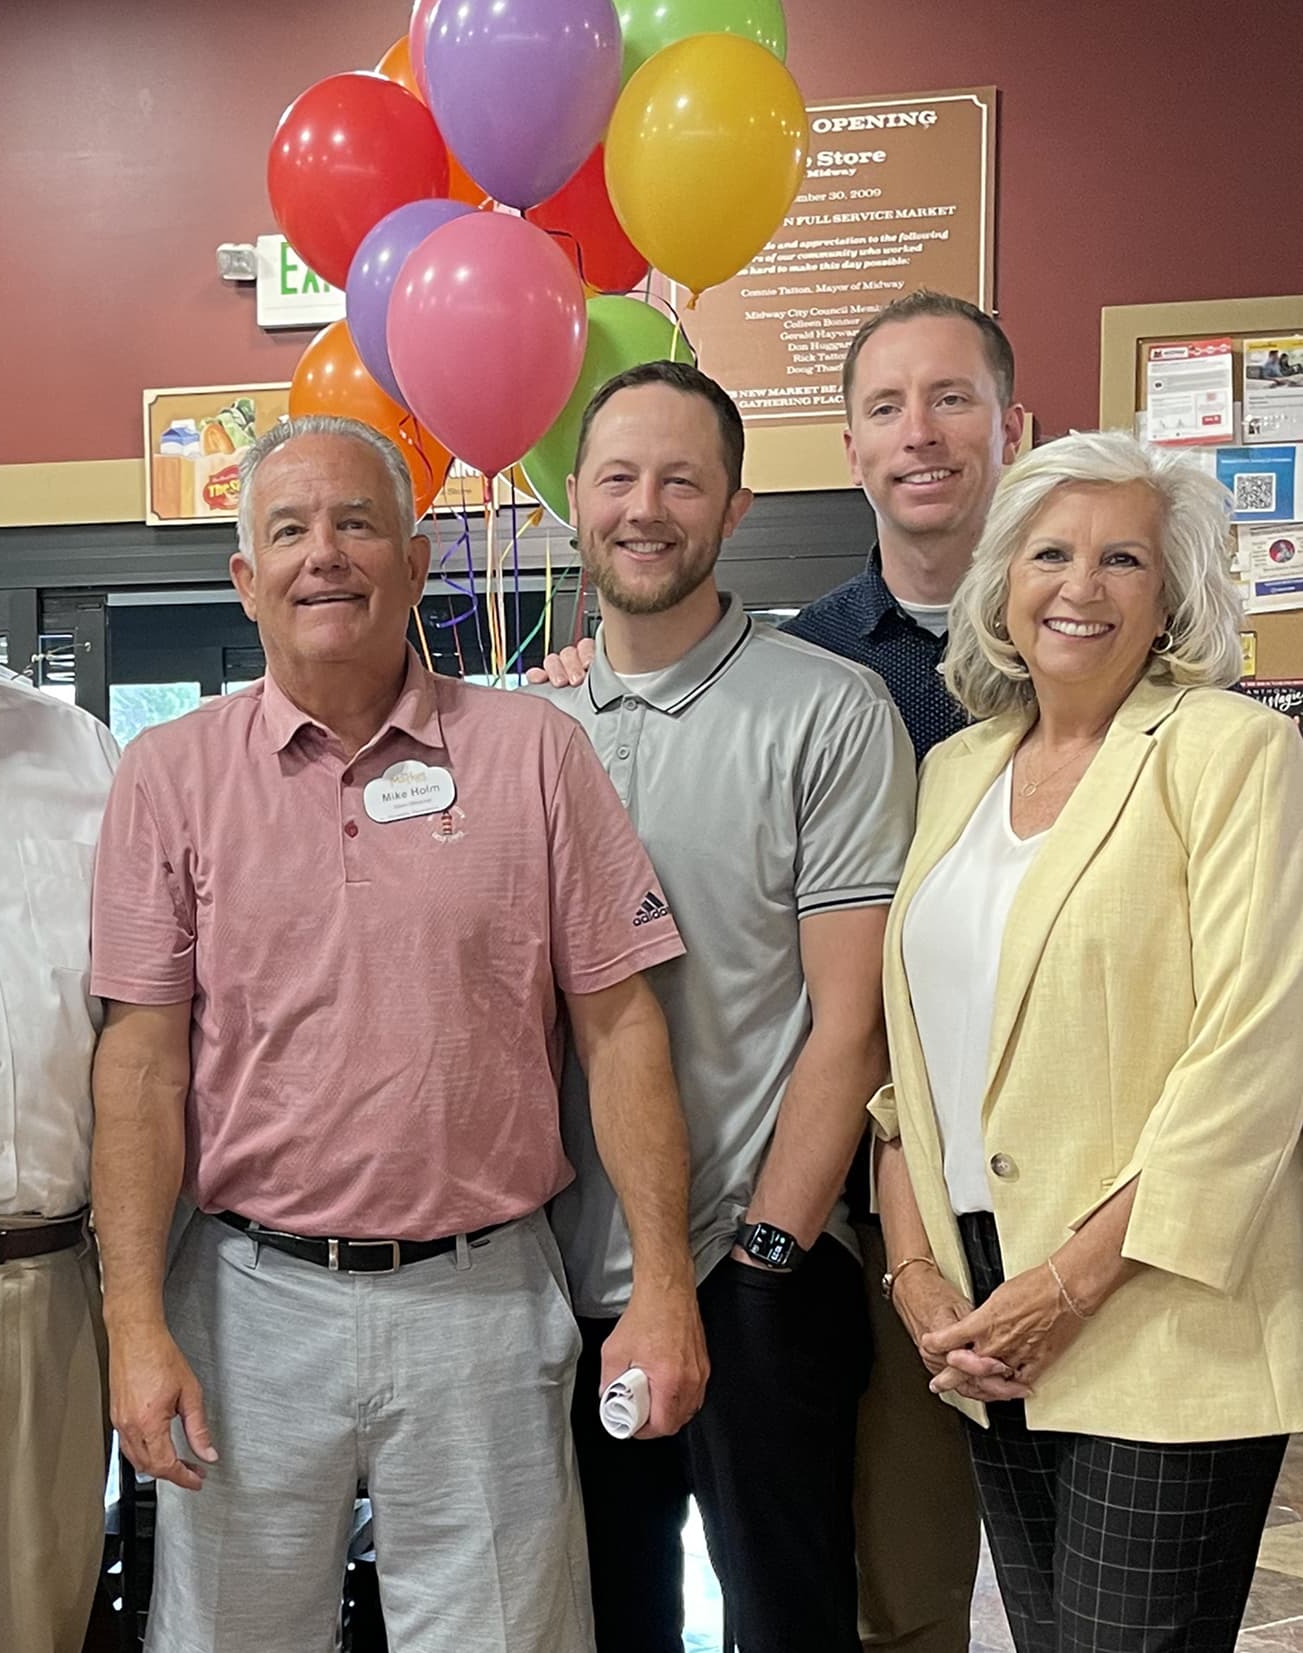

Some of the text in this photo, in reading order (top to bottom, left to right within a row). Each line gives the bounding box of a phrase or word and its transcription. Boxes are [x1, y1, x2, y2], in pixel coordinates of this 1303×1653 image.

[812, 110, 938, 134] OPENING
[816, 150, 887, 167] Store
[806, 168, 857, 178] Midway
[849, 188, 882, 199] 2009
[795, 214, 832, 226] FULL
[832, 209, 894, 223] SERVICE
[894, 206, 957, 219] MARKET
[776, 240, 799, 249] and
[799, 236, 867, 249] appreciation
[867, 235, 880, 243] to
[880, 234, 897, 242] the
[898, 229, 949, 243] following
[764, 252, 777, 263] of
[796, 248, 858, 261] community
[858, 247, 882, 256] who
[882, 243, 923, 254] worked
[749, 264, 777, 275] hard
[777, 264, 788, 273] to
[789, 262, 818, 272] make
[819, 261, 840, 271] this
[841, 260, 863, 270] day
[815, 283, 850, 293] Mayor
[850, 281, 862, 291] of
[862, 280, 905, 290] Midway
[744, 311, 787, 321] Midway
[787, 308, 809, 318] City
[809, 305, 849, 317] Council
[783, 319, 822, 330] Colleen
[779, 330, 815, 341] Gerald
[787, 342, 809, 352] Don
[793, 353, 817, 363] Rick
[785, 365, 814, 376] Doug
[739, 388, 767, 399] NEW
[767, 385, 820, 397] MARKET
[820, 384, 837, 394] BE
[738, 396, 812, 409] GATHERING
[381, 784, 440, 802] Mike Holm
